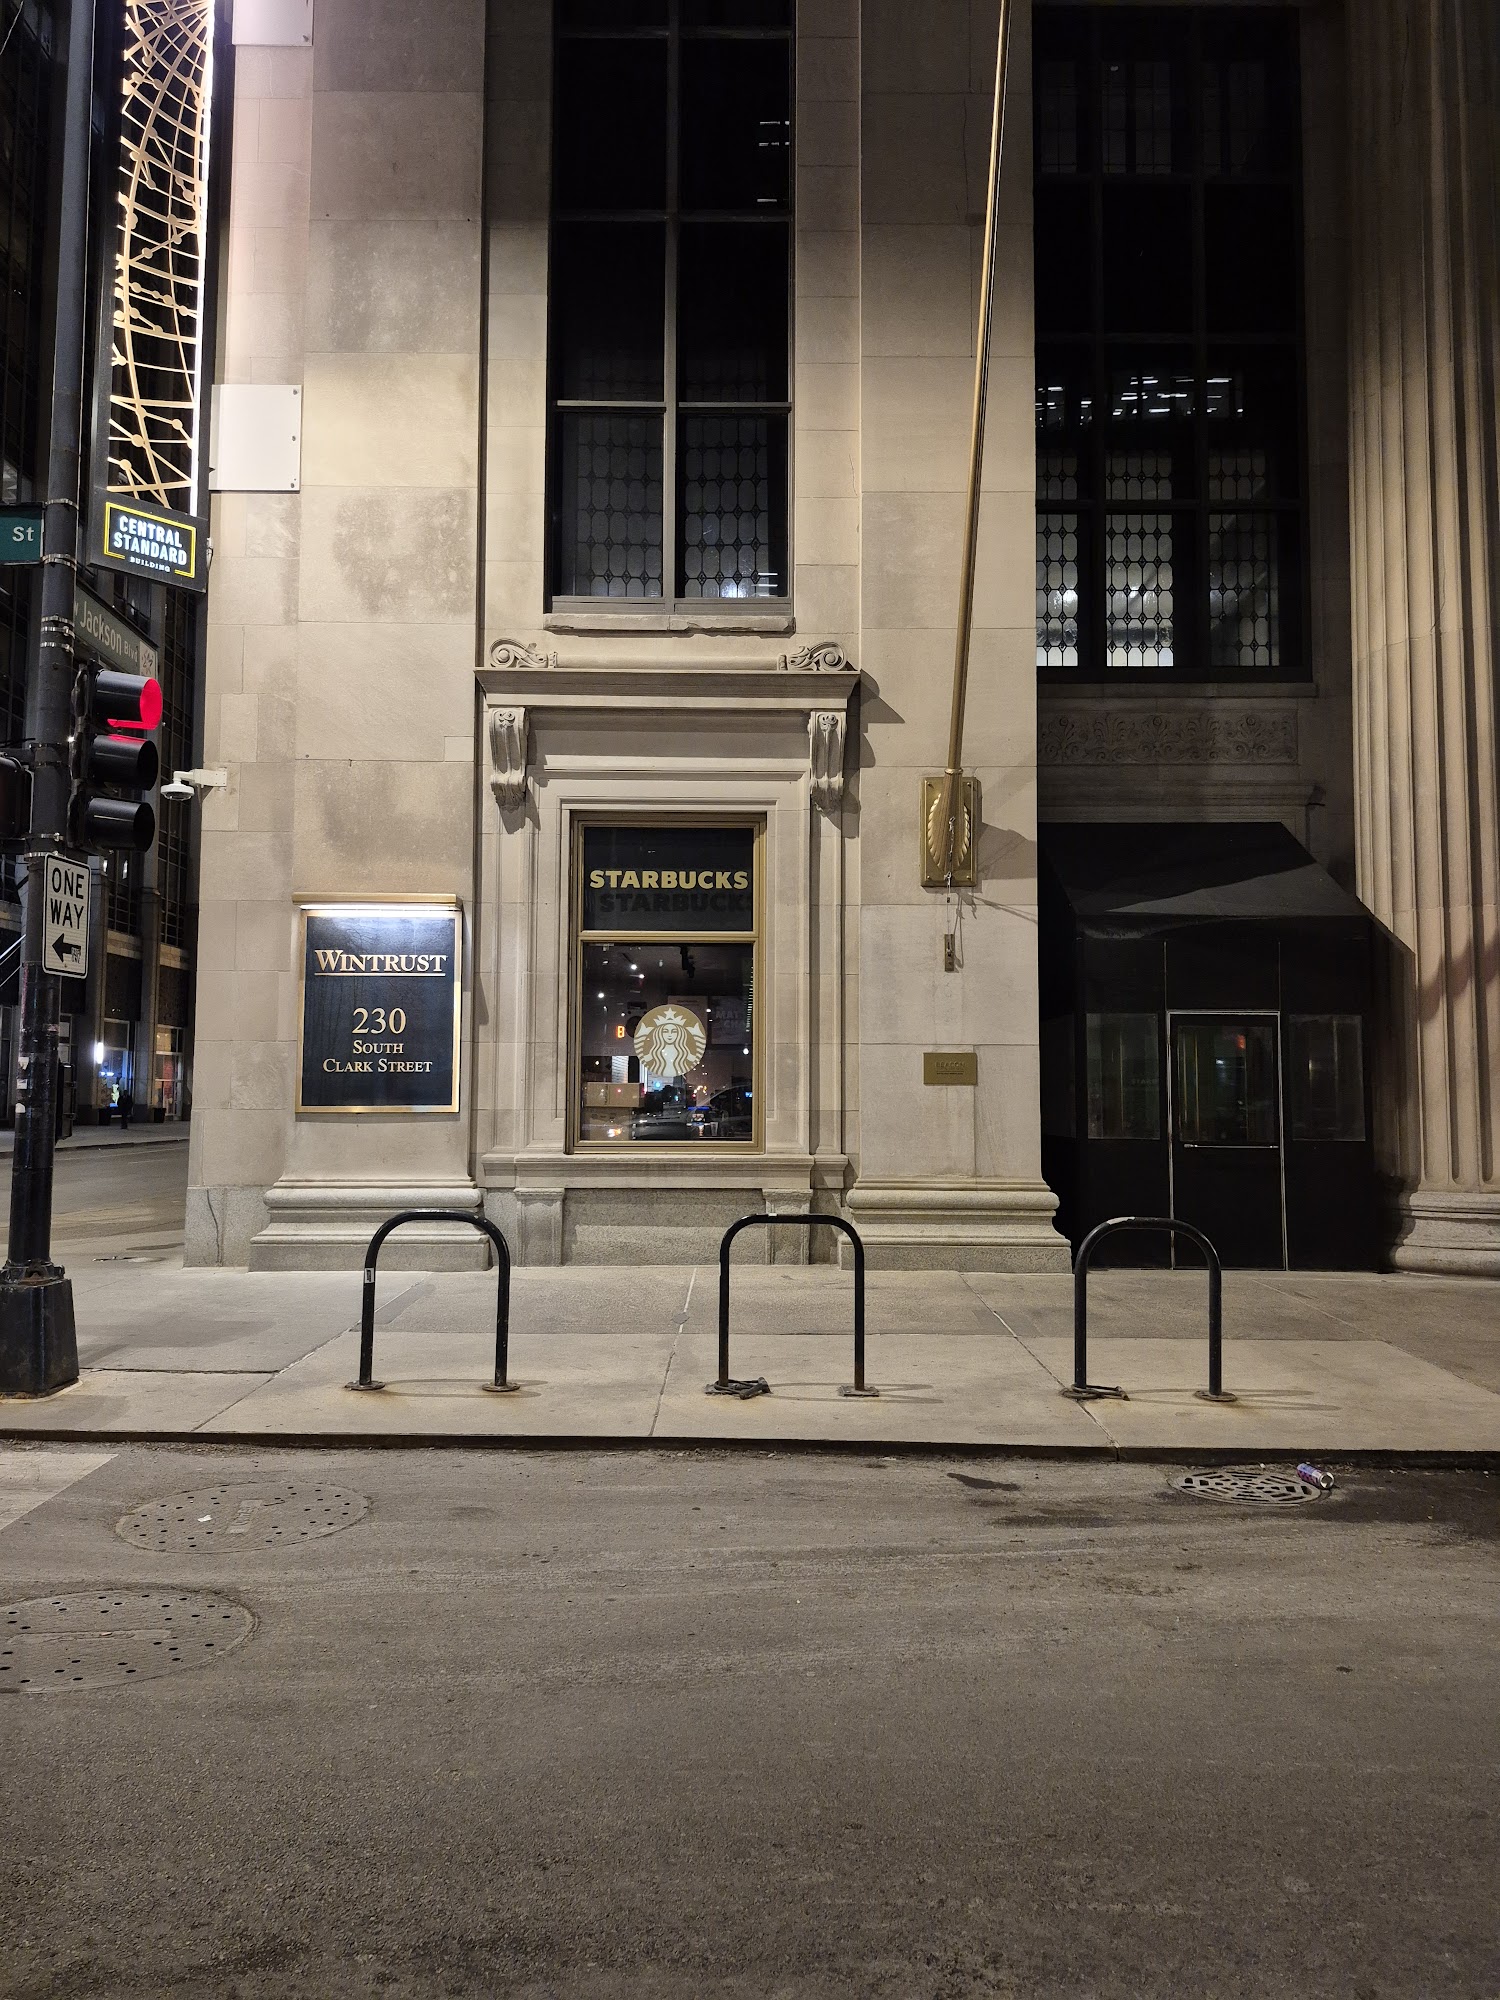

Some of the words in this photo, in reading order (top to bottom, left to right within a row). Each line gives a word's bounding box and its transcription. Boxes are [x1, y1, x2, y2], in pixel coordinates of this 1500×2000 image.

[12, 526, 35, 542] St
[119, 515, 182, 548] CENTRAL
[113, 531, 188, 566] STANDARD
[129, 556, 171, 573] BUILDING
[80, 601, 122, 655] Jackson
[124, 640, 138, 662] Blvd
[52, 868, 84, 899] ONE
[590, 870, 748, 889] STARBUCKS
[50, 898, 84, 929] WAY
[352, 1008, 406, 1034] 230
